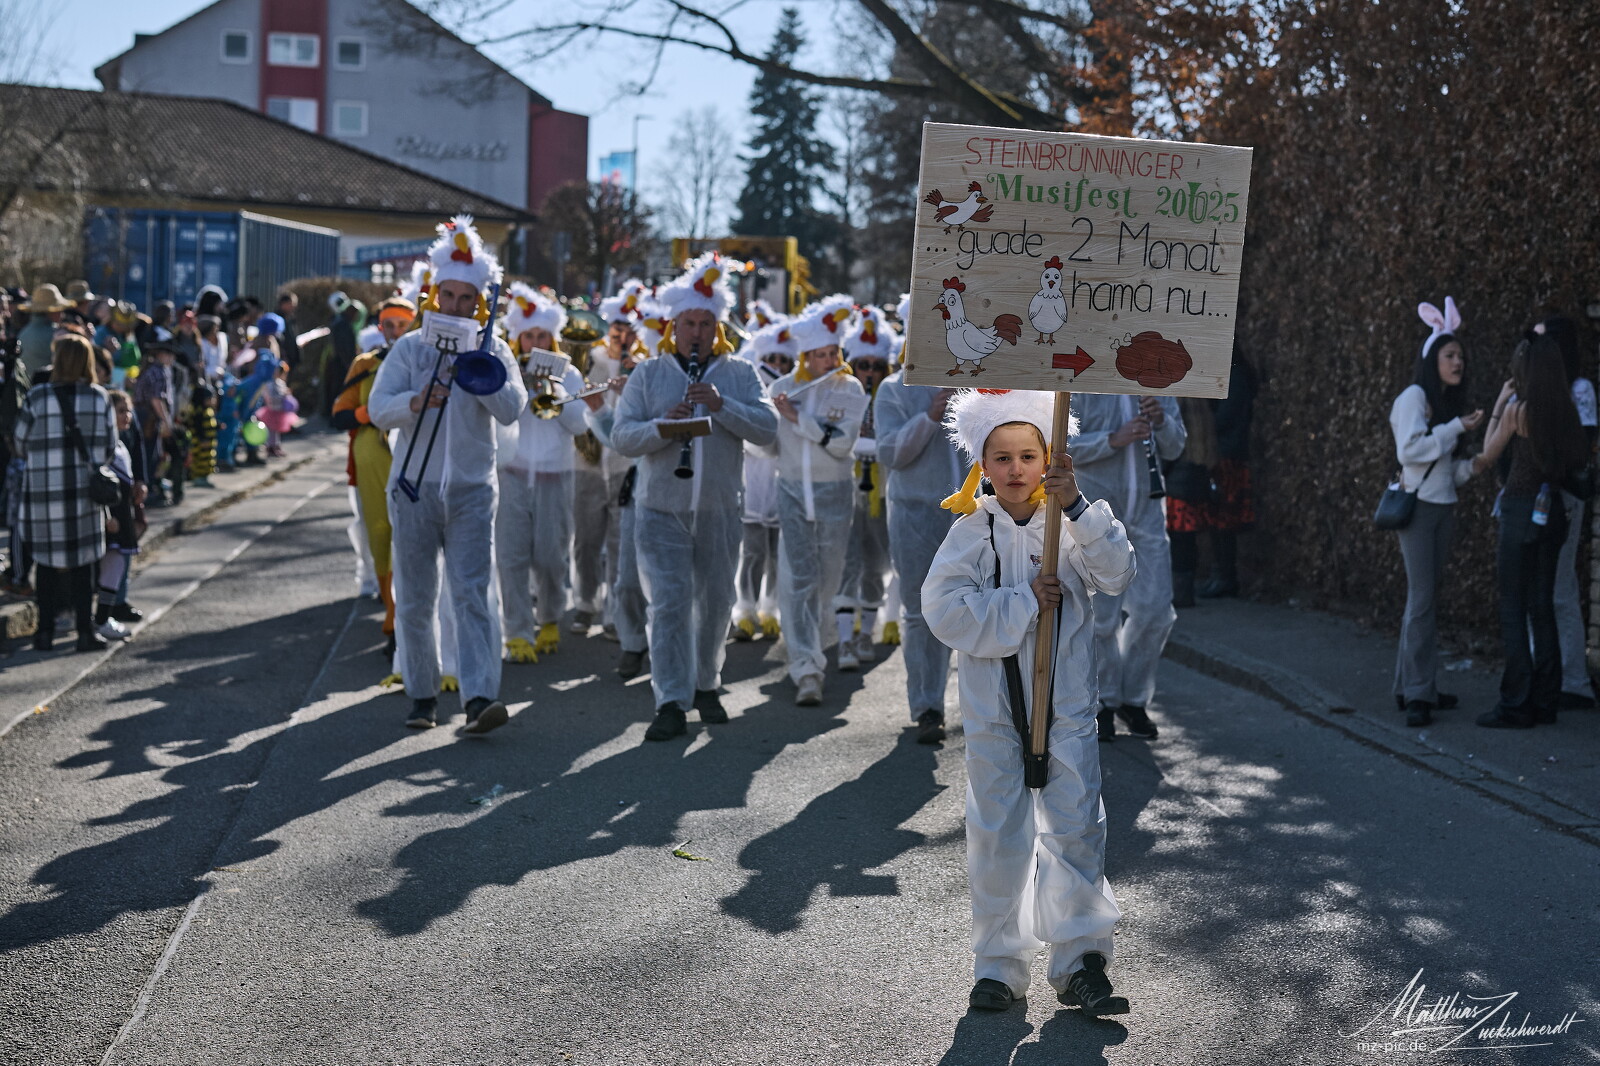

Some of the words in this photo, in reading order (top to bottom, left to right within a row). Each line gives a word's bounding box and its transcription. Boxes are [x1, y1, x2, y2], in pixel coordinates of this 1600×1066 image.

[965, 137, 1183, 180] STEINBRÜNNINGER
[986, 172, 1138, 218] Musifest
[1068, 217, 1093, 262] 2
[1117, 221, 1220, 273] Monat
[1071, 270, 1153, 313] hama
[1166, 286, 1228, 317] nu...
